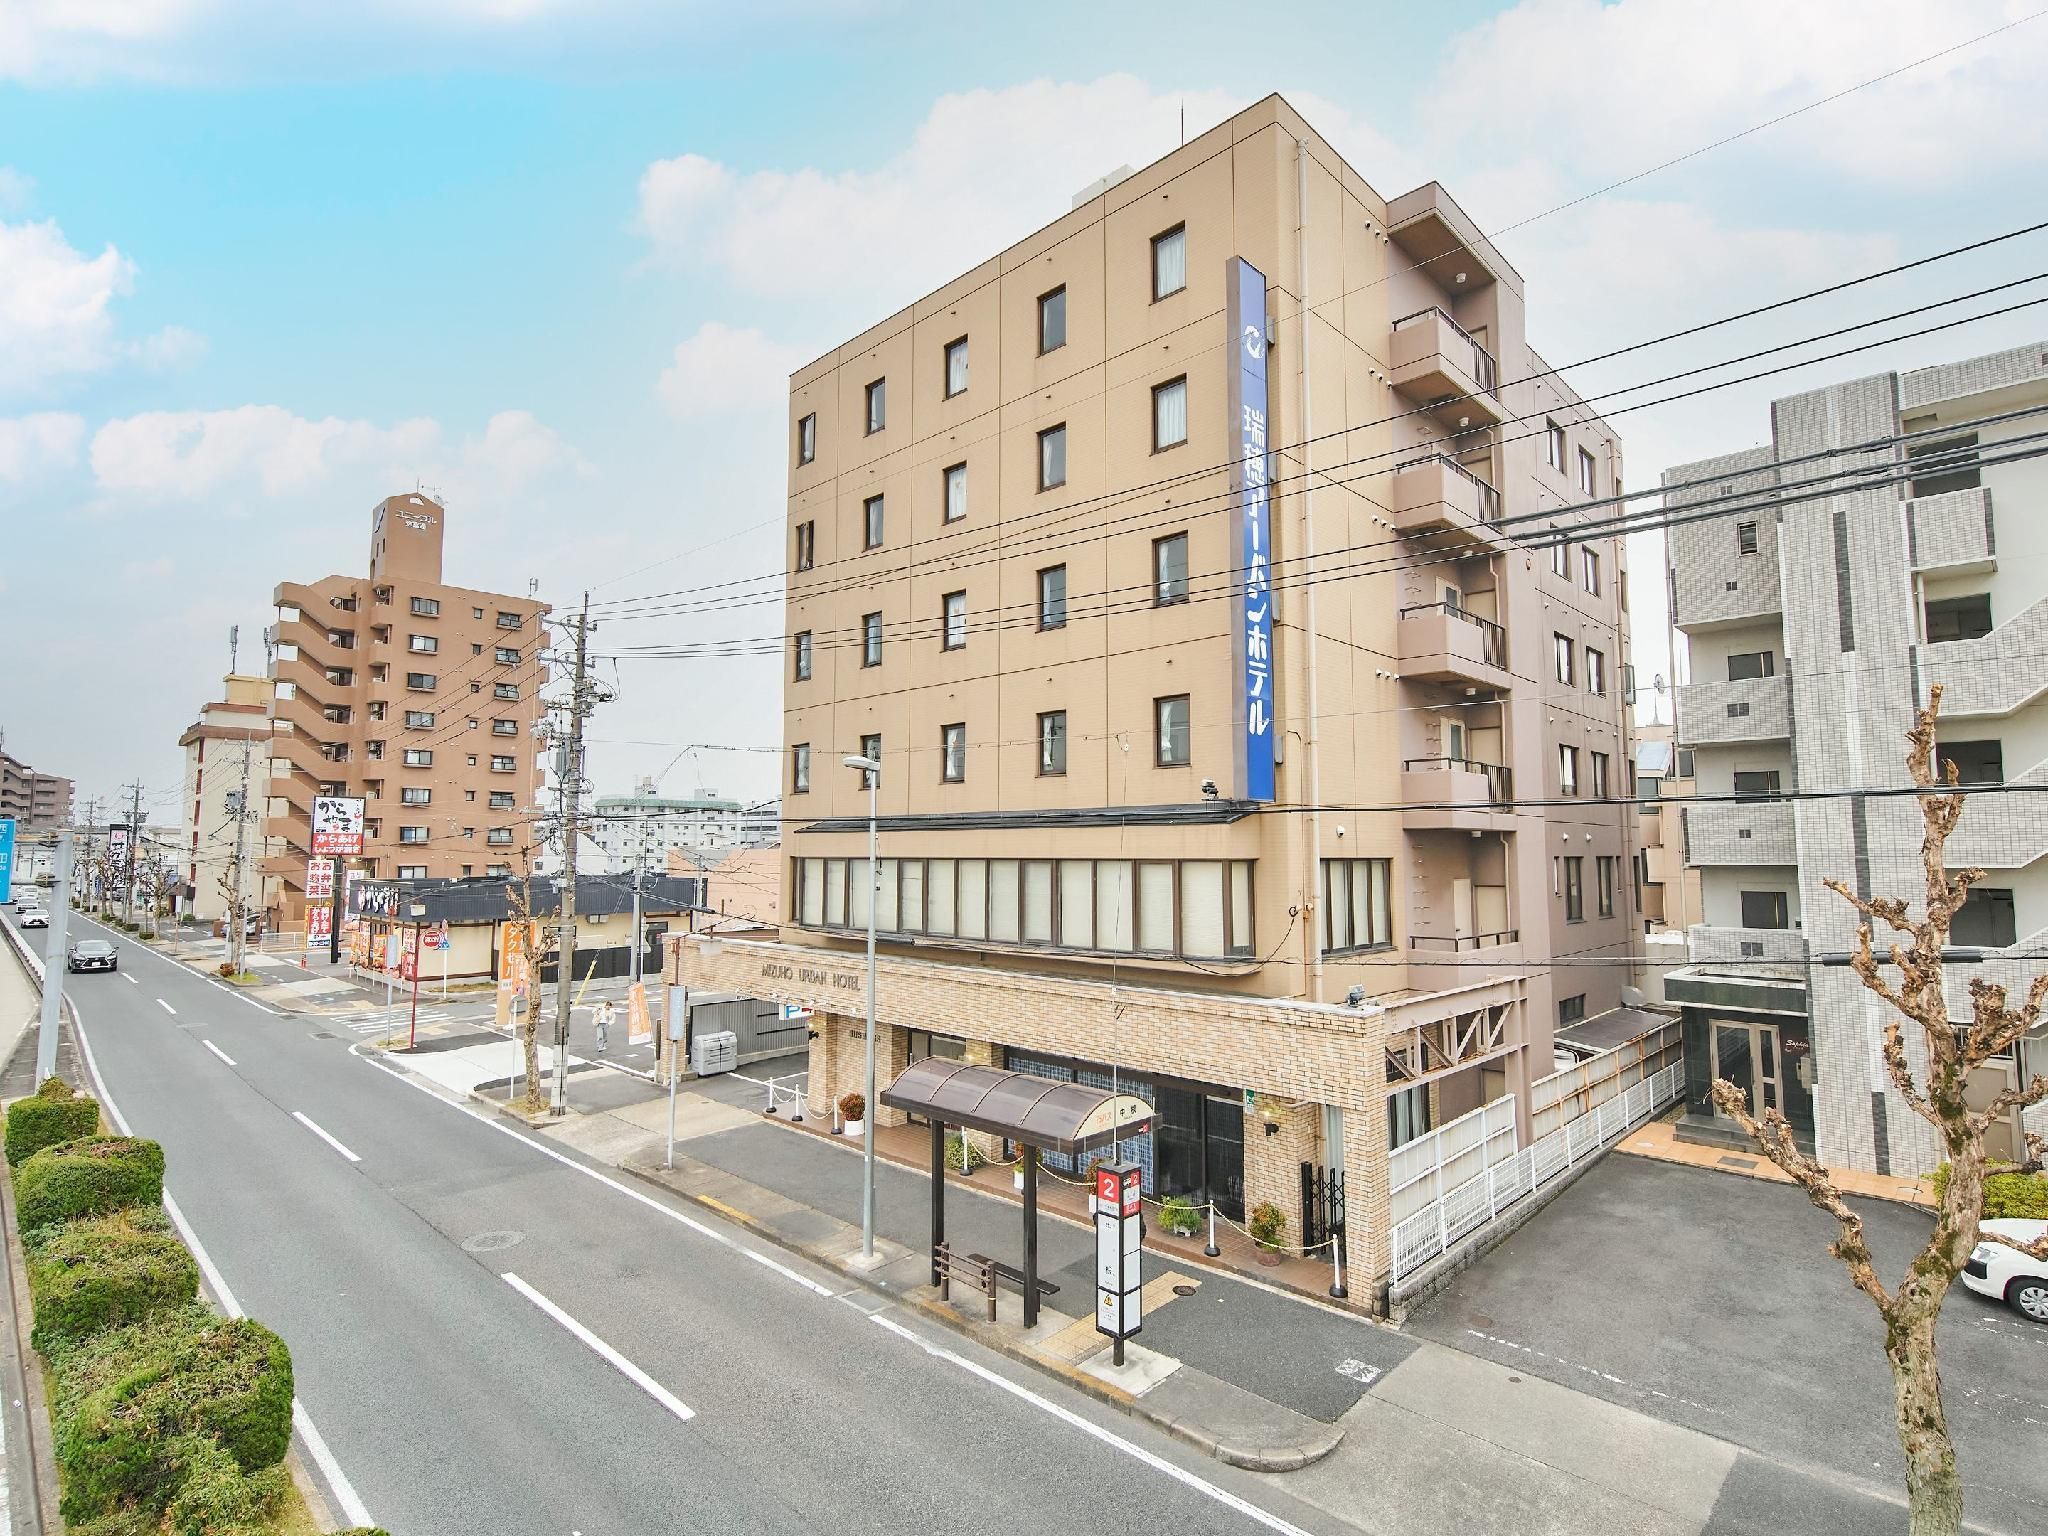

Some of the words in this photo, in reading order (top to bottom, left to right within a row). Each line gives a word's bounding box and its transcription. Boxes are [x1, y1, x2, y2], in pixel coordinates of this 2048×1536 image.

[318, 800, 347, 815] から
[316, 834, 360, 844] からあげ
[320, 862, 332, 895] お弁当
[762, 964, 793, 980] MIZUHO
[799, 968, 827, 985] URBAN
[833, 974, 860, 991] HOTEL
[786, 1005, 800, 1018] P
[1103, 1178, 1115, 1199] 2
